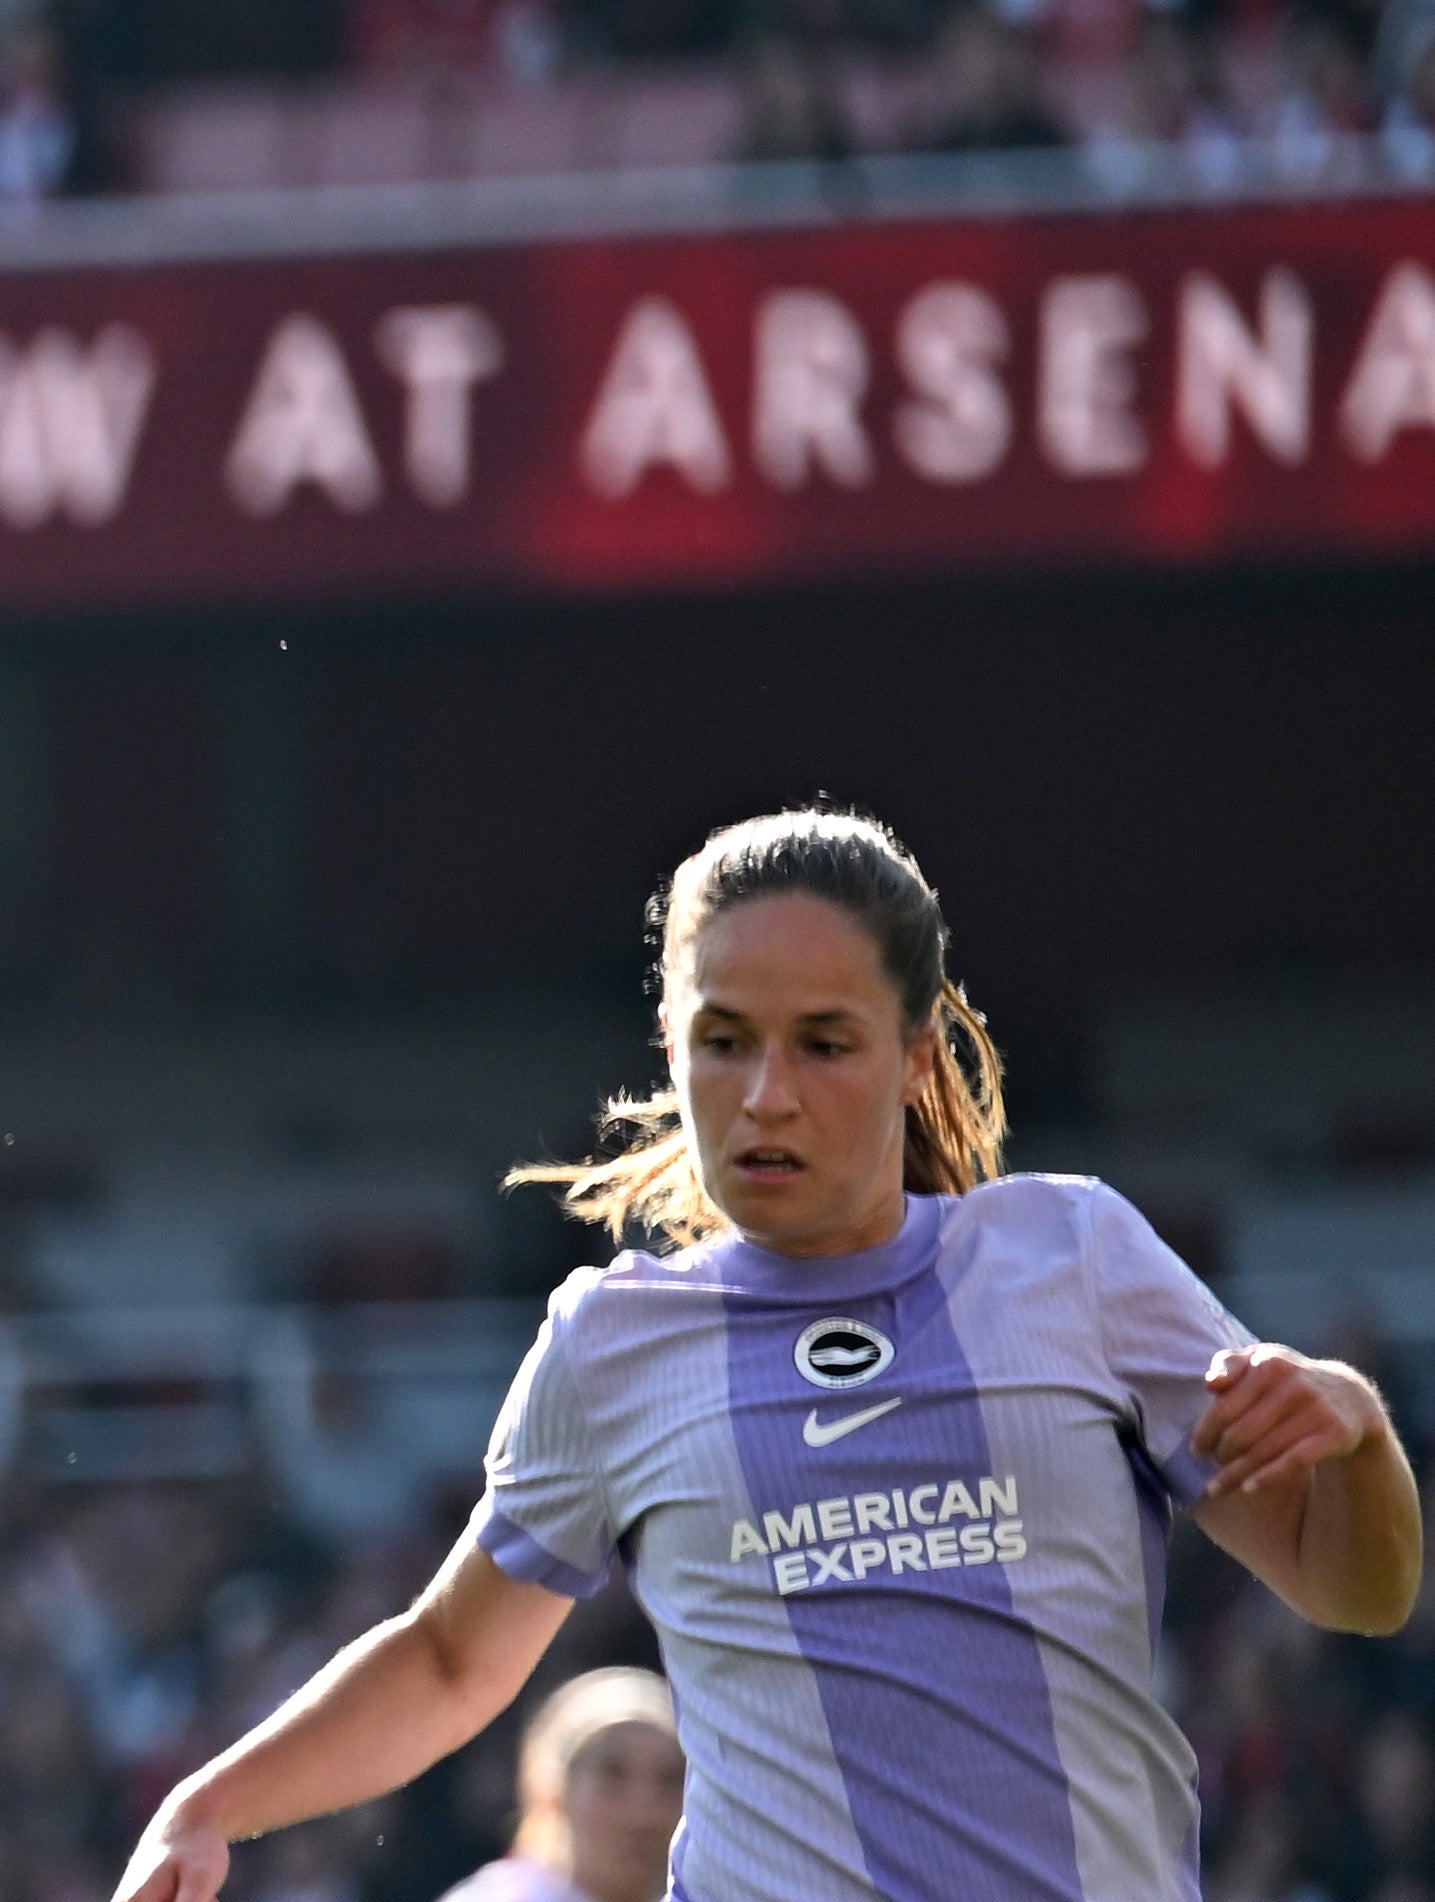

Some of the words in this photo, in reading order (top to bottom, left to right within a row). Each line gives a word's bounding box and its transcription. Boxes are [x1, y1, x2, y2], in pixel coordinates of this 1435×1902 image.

[224, 304, 502, 515] AT
[582, 258, 1435, 498] ARSENA
[730, 1474, 1019, 1563] AMERICAN
[773, 1519, 1028, 1596] EXPRESS
